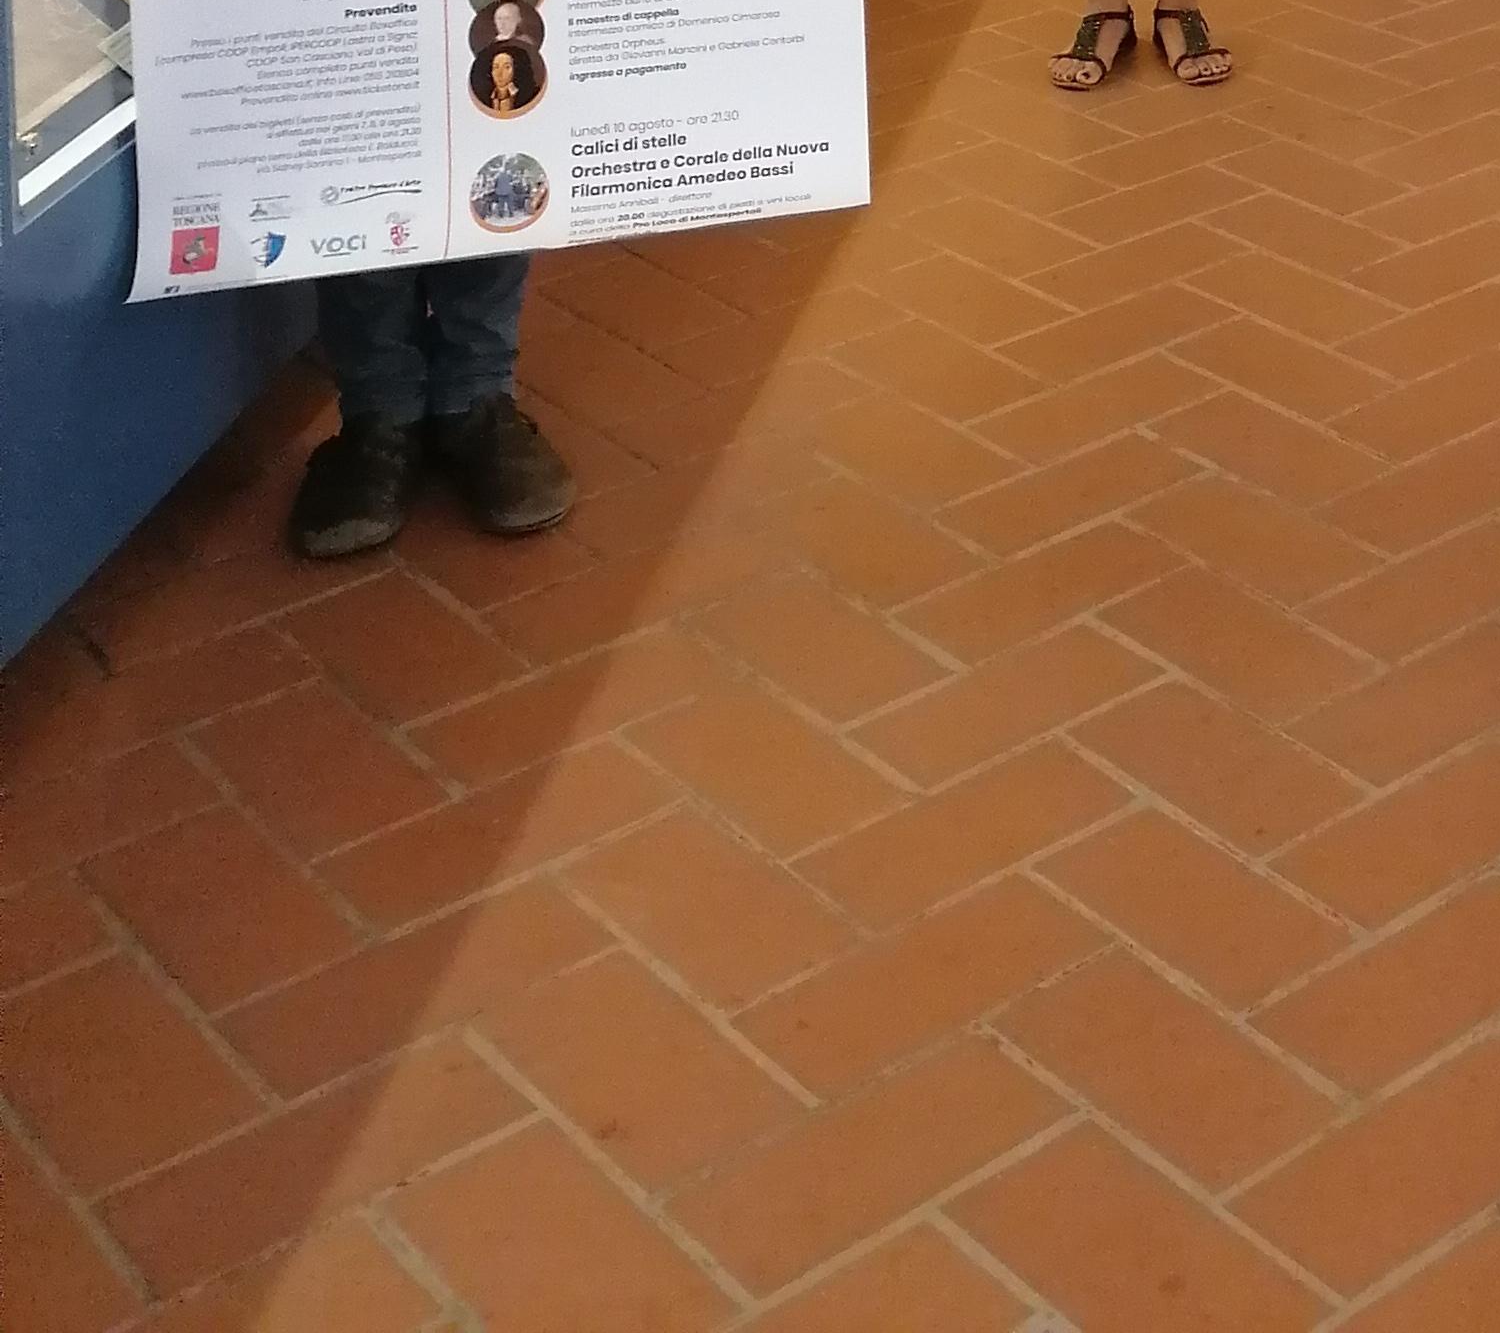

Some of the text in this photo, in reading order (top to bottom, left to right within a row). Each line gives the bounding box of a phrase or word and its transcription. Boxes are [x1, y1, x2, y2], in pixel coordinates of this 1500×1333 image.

[344, 2, 417, 18] Prevendita
[570, 123, 611, 138] lunedì
[628, 118, 674, 134] agosto
[571, 133, 687, 156] Calici di stelle
[571, 141, 829, 178] Orchestra e Corale della Nuova
[571, 161, 794, 198] Filarmonica Amedeo Bassi
